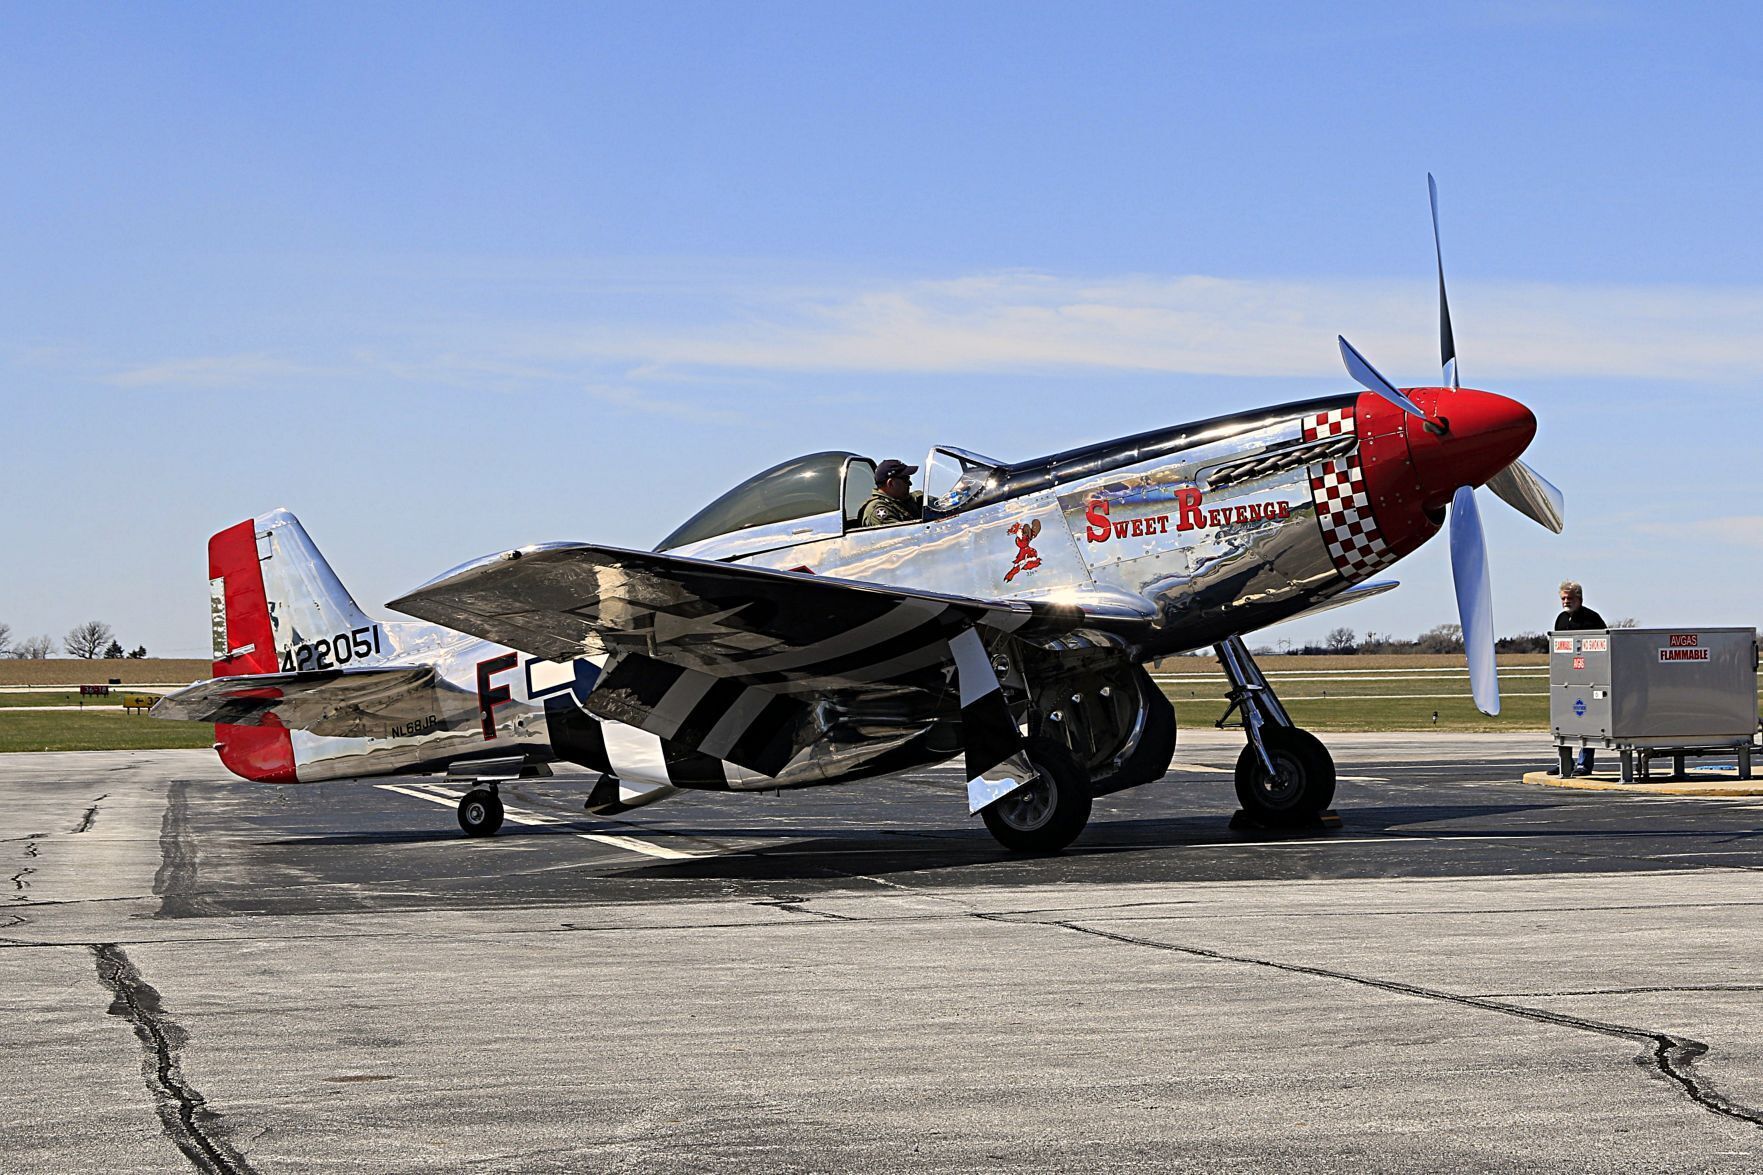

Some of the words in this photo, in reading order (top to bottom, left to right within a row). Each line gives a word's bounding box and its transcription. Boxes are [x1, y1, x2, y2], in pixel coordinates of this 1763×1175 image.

[1085, 499, 1169, 543] SWEET
[1173, 487, 1291, 532] REVENGE
[281, 624, 381, 672] 422051
[1660, 649, 1708, 661] FLAMMABLE
[1671, 635, 1697, 646] AVGAS
[477, 651, 518, 741] F
[391, 714, 437, 739] NL68JR
